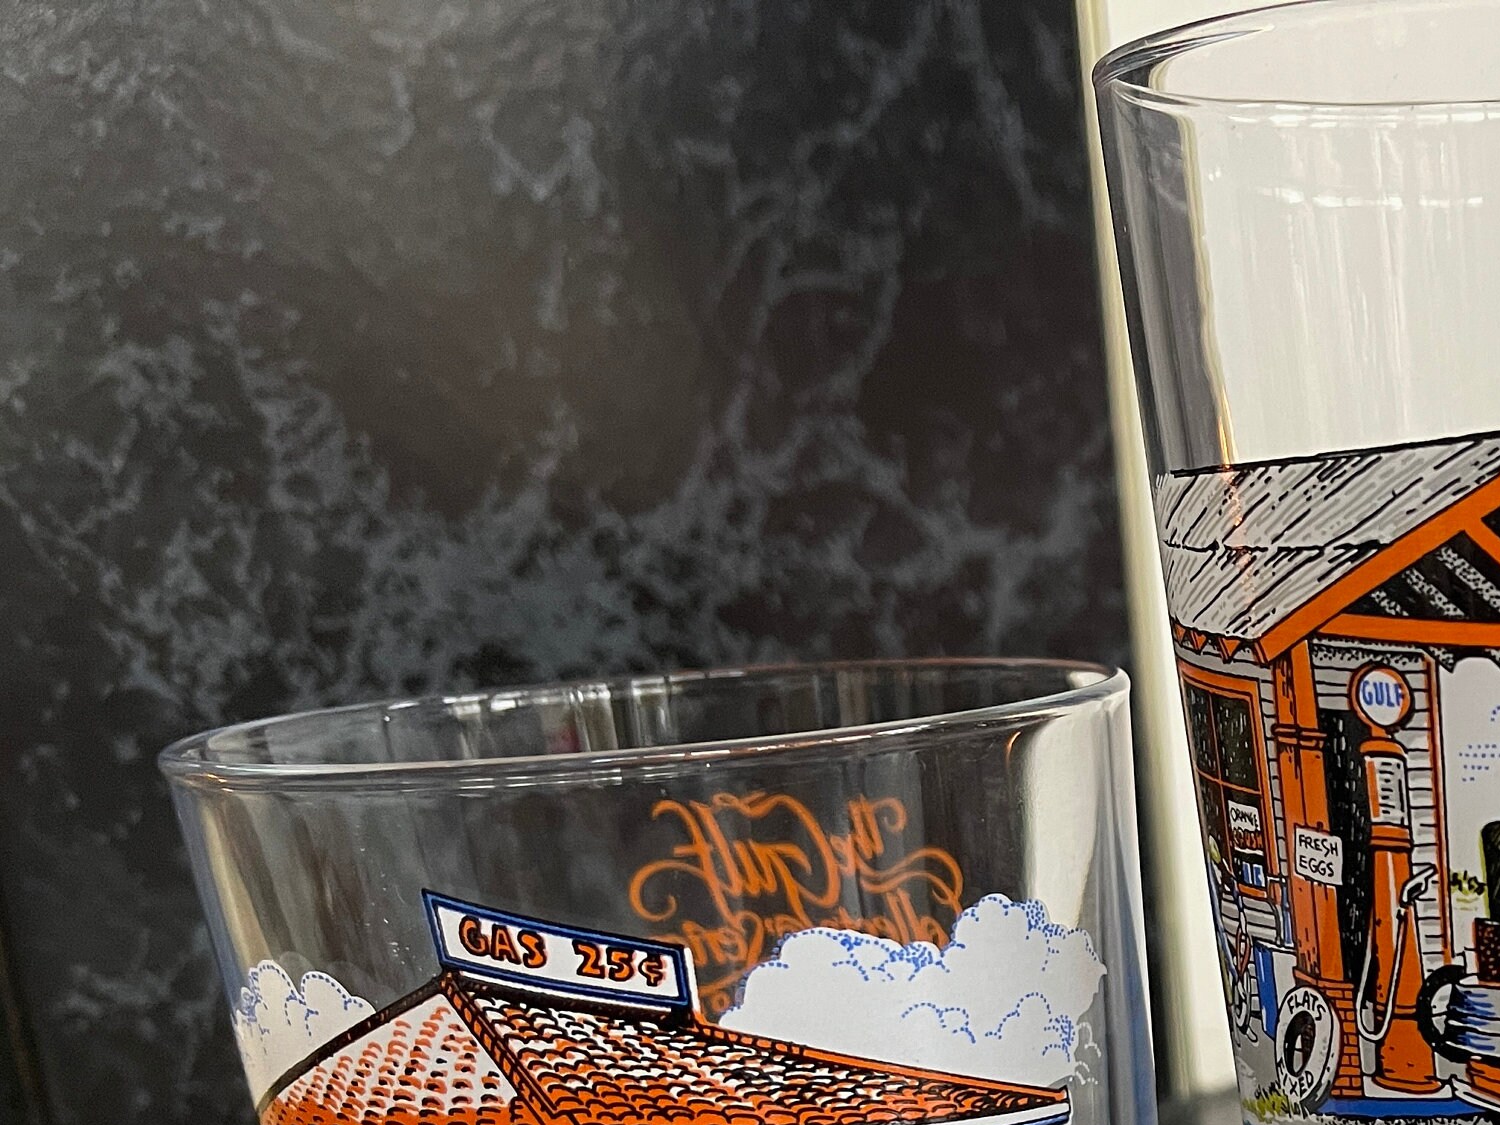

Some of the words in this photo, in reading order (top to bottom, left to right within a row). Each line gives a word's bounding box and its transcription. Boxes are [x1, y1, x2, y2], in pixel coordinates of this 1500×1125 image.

[1299, 834, 1338, 857] FRESH
[1299, 857, 1335, 877] EGGS
[458, 915, 547, 968] GAS
[571, 938, 666, 987] 25¢
[1287, 991, 1327, 1022] FLATS
[1277, 1056, 1315, 1098] FIXED
